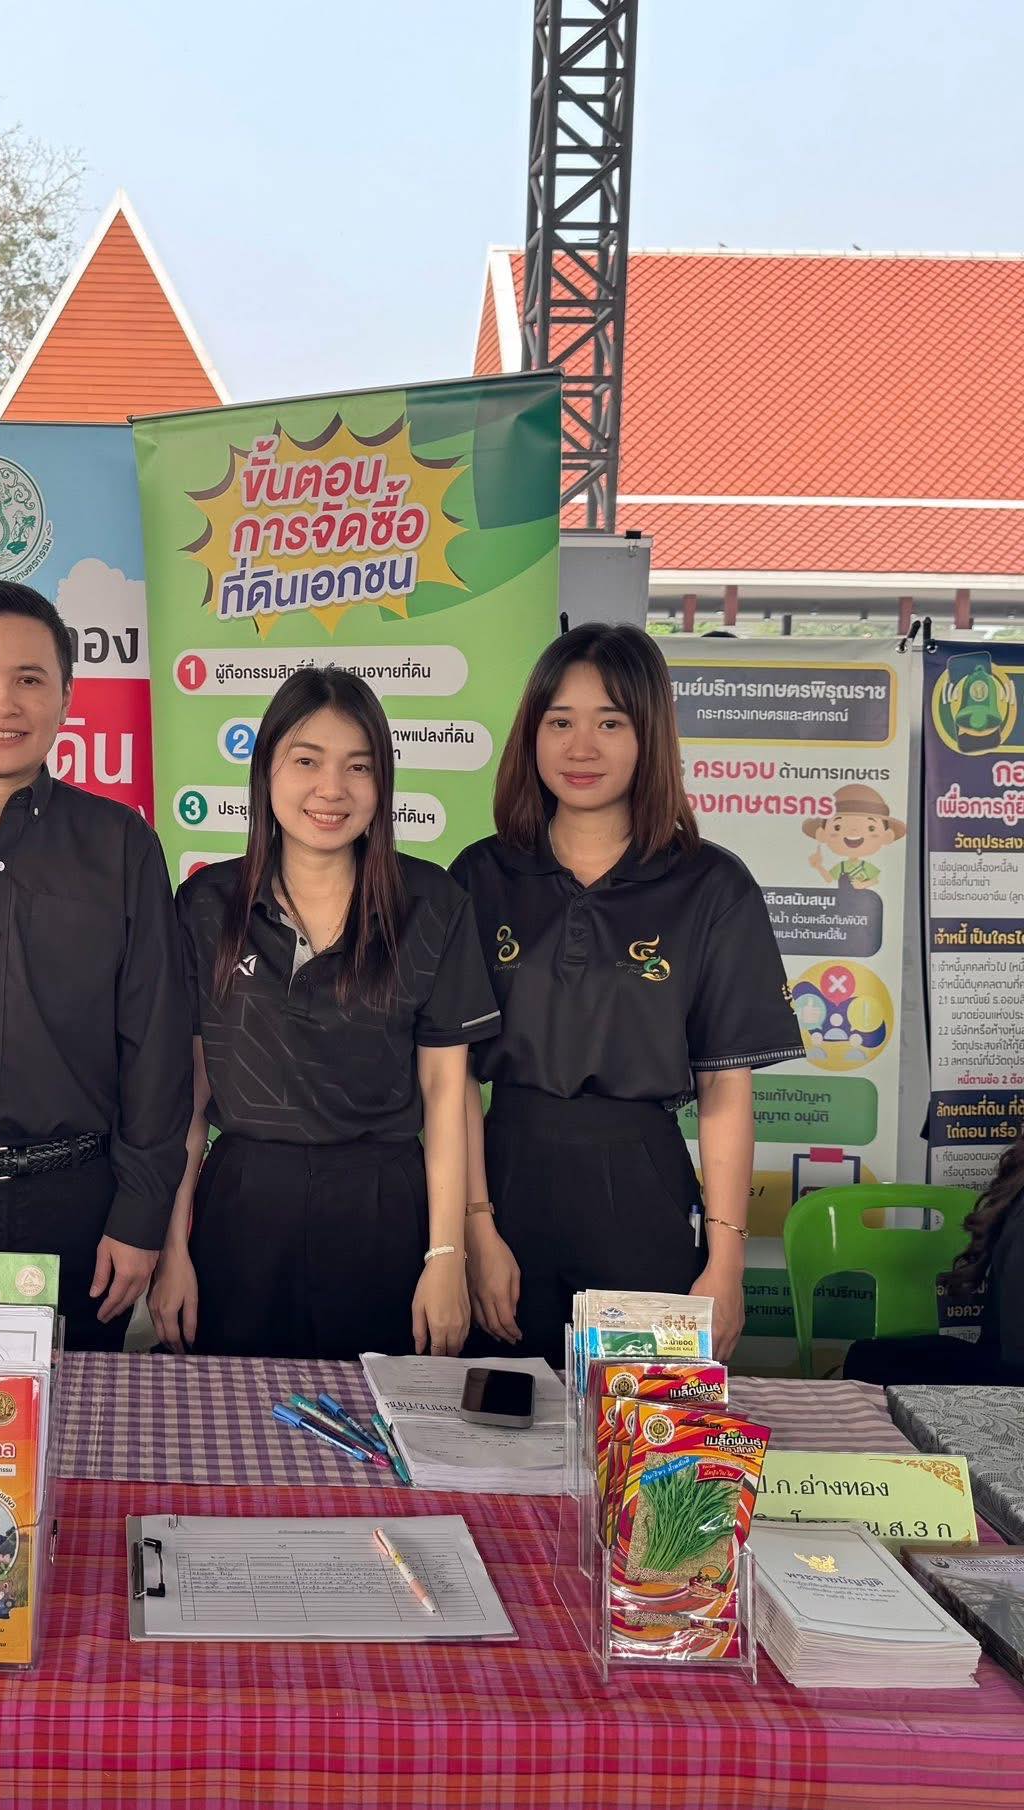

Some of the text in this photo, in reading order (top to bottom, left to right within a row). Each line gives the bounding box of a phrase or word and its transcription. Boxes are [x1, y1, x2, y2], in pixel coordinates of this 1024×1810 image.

[242, 440, 383, 502] ขั้นตอน
[233, 480, 425, 553] การจัดซื้อ
[220, 555, 412, 615] ที่ดินเอกชน
[185, 660, 197, 684] 1
[696, 708, 849, 722] กระทรวงเกษตรและสหกรณ์
[233, 722, 474, 755] 2 าพแปลงที่ดิน
[693, 760, 890, 781] ครบจบ ด้านการเกษตร
[185, 796, 201, 820] 3
[218, 800, 248, 820] ประชุ
[954, 832, 1024, 855] วัตถุประสง
[773, 928, 846, 942] แนะนำด้านหนี้สิน
[752, 1088, 831, 1105] ารแก้ไขปัญหา
[753, 1111, 790, 1125] นุญาต
[937, 1522, 952, 1538] ก
